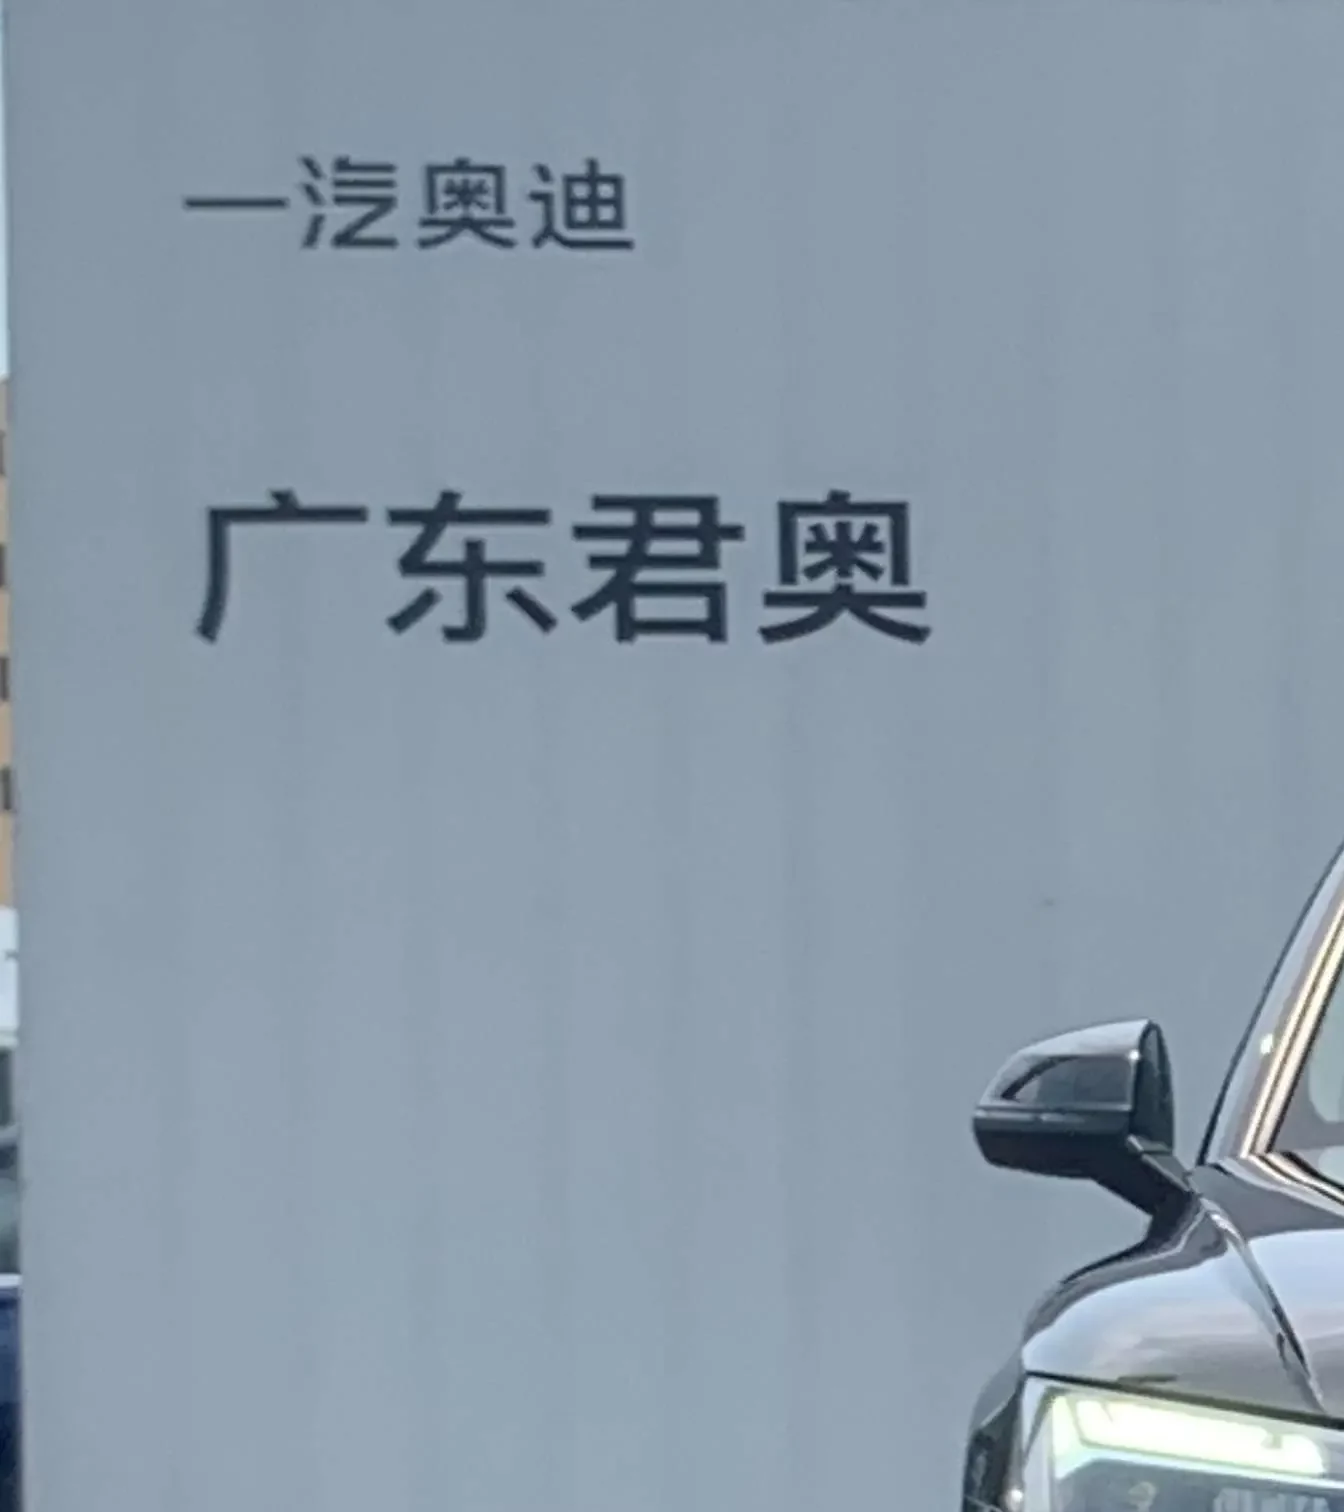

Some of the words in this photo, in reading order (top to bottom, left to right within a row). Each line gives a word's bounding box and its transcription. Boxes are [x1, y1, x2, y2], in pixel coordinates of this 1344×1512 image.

[184, 156, 635, 251] 一汽奥迪
[196, 489, 931, 645] 广东君奥
